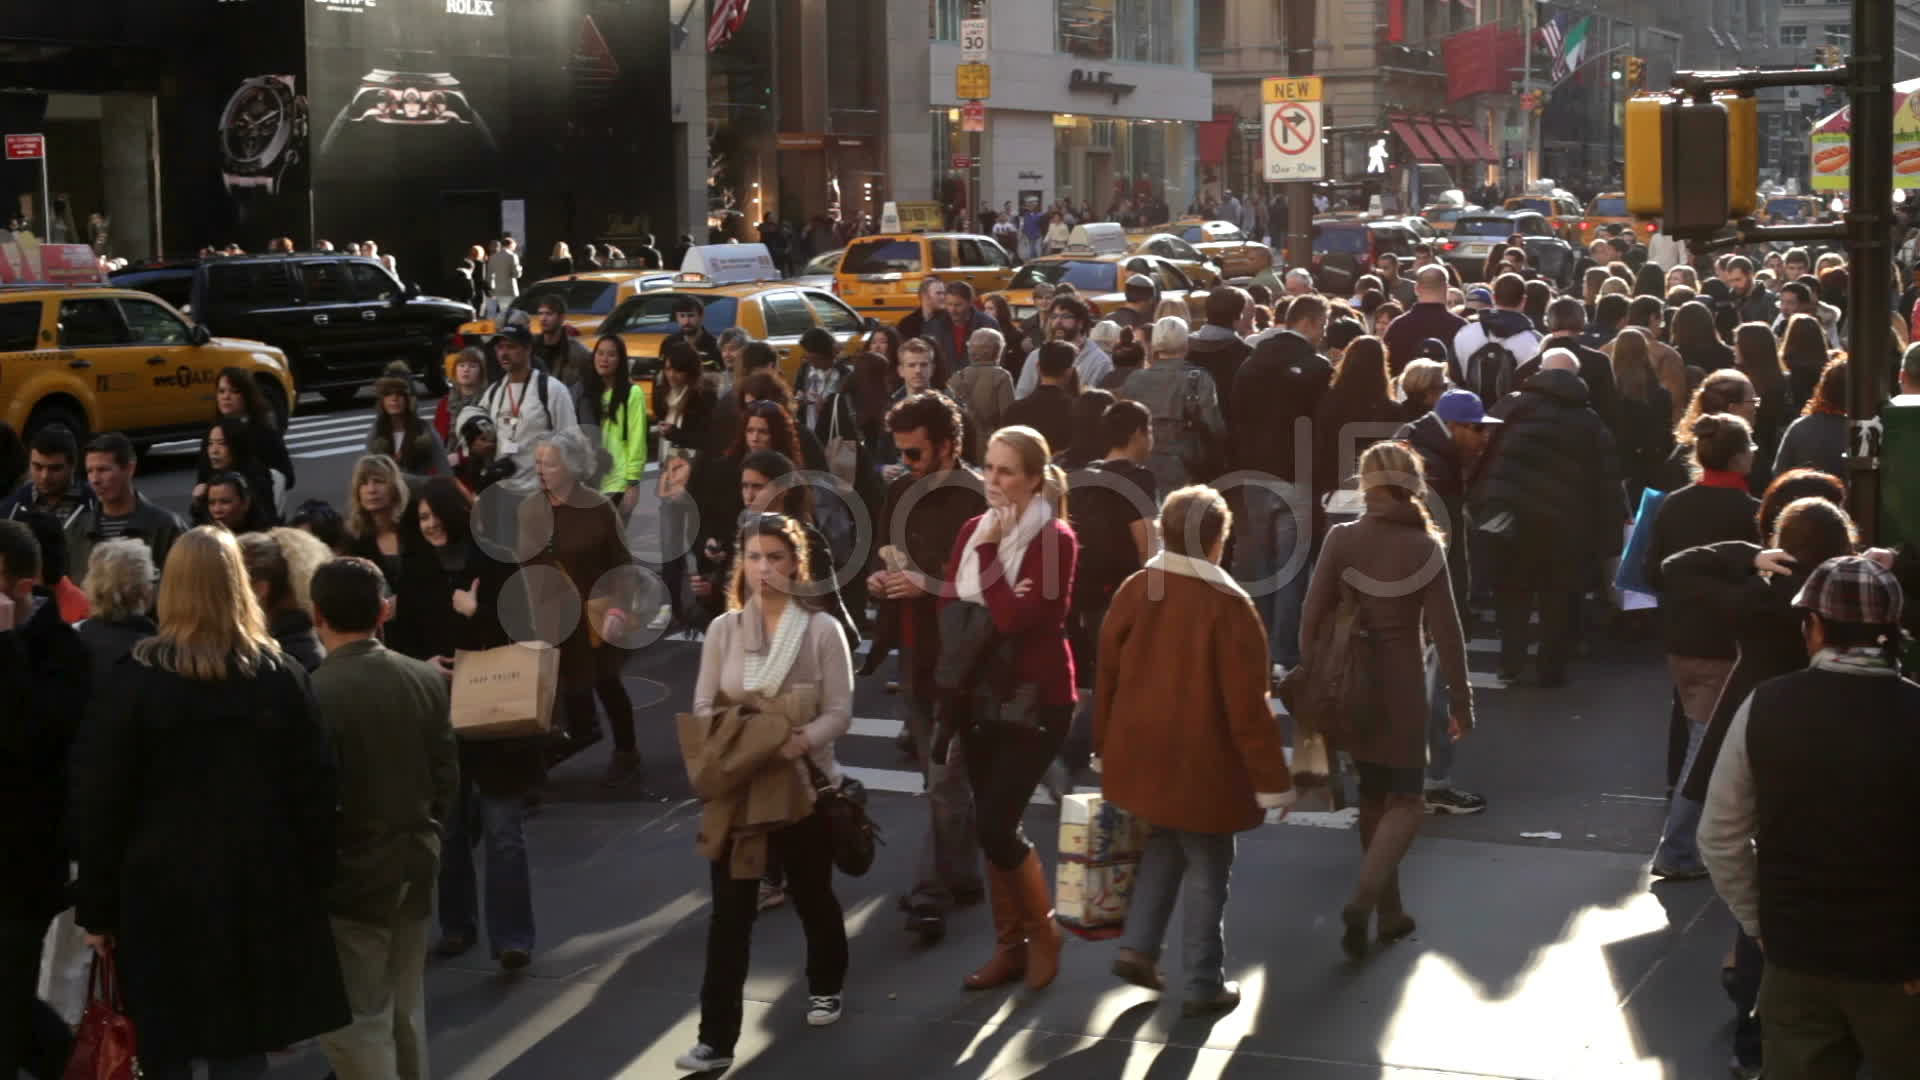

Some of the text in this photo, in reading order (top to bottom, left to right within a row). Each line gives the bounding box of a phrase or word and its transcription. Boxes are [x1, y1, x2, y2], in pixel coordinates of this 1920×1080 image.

[446, 0, 495, 16] ROLEX
[963, 36, 985, 50] 30
[1273, 81, 1310, 98] NEW
